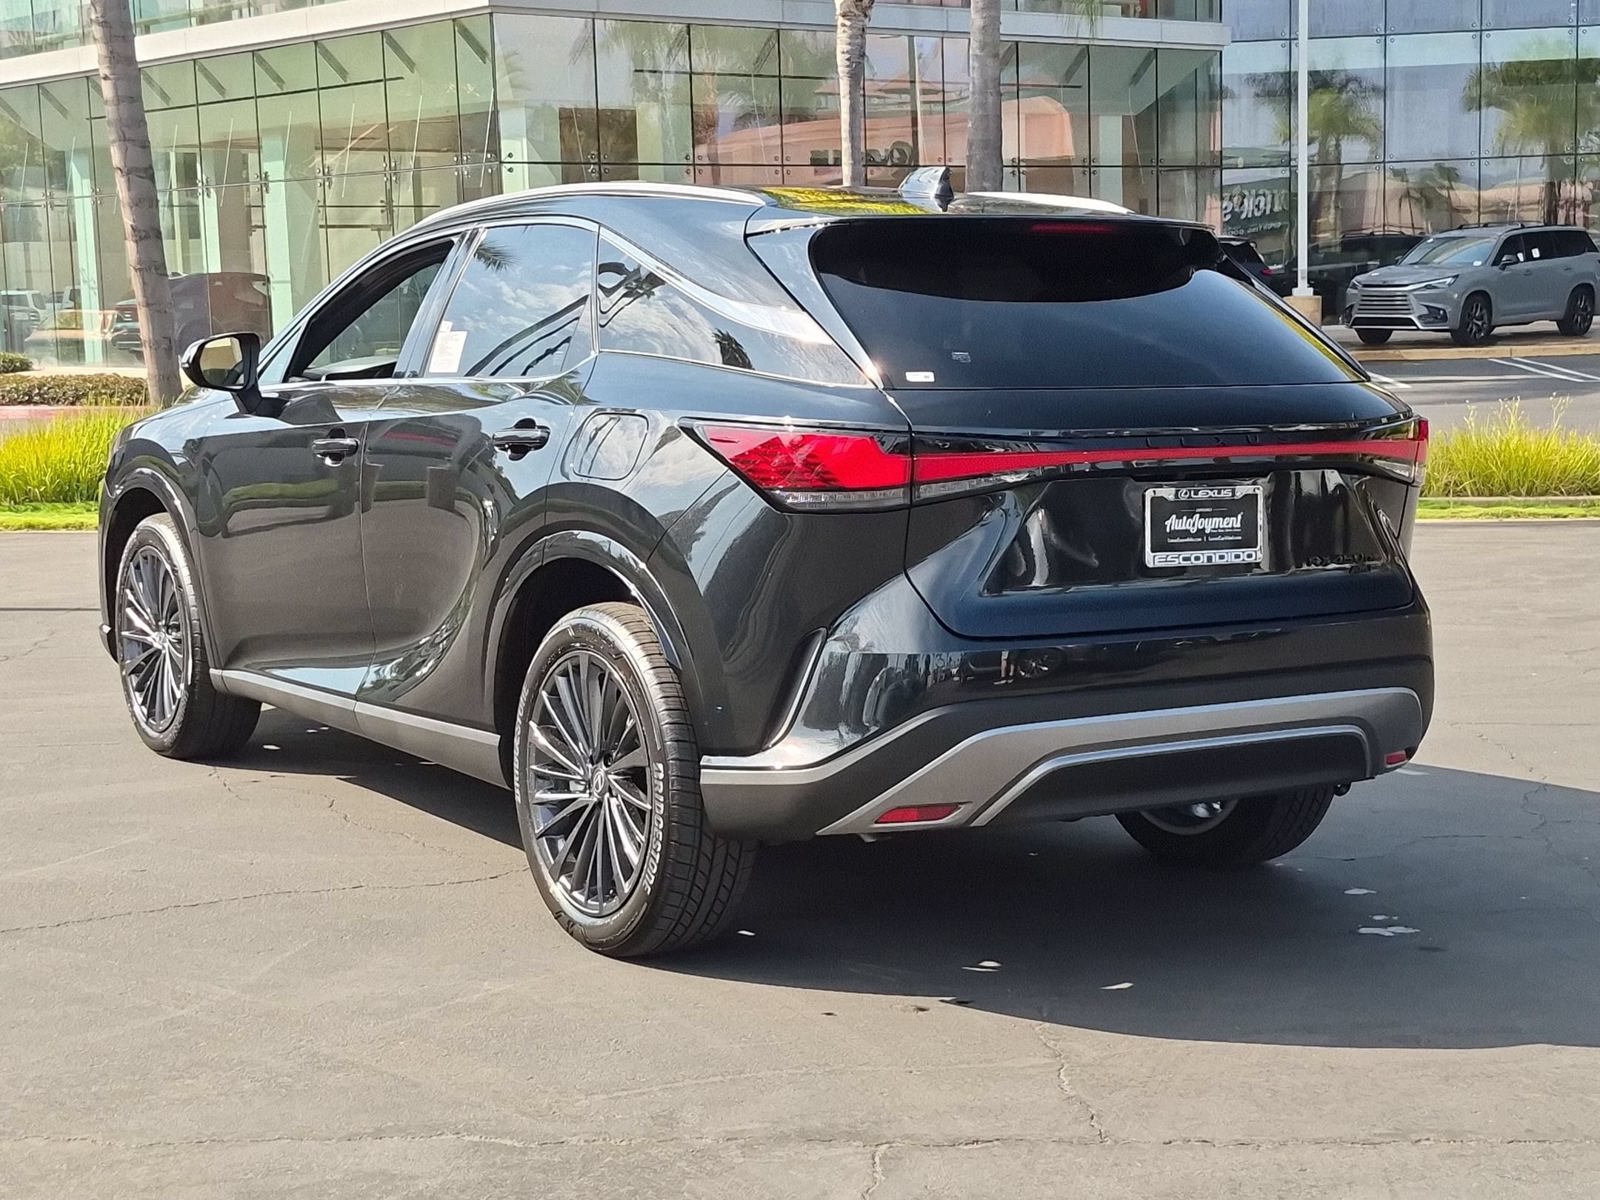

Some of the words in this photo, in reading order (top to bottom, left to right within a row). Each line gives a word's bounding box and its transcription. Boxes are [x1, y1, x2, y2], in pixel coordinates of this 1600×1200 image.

[1190, 489, 1232, 498] LEXUS
[1164, 513, 1242, 533] AutoJoyment
[1154, 551, 1256, 565] ESCONDIDO
[643, 762, 665, 896] BRIDGESTONE
